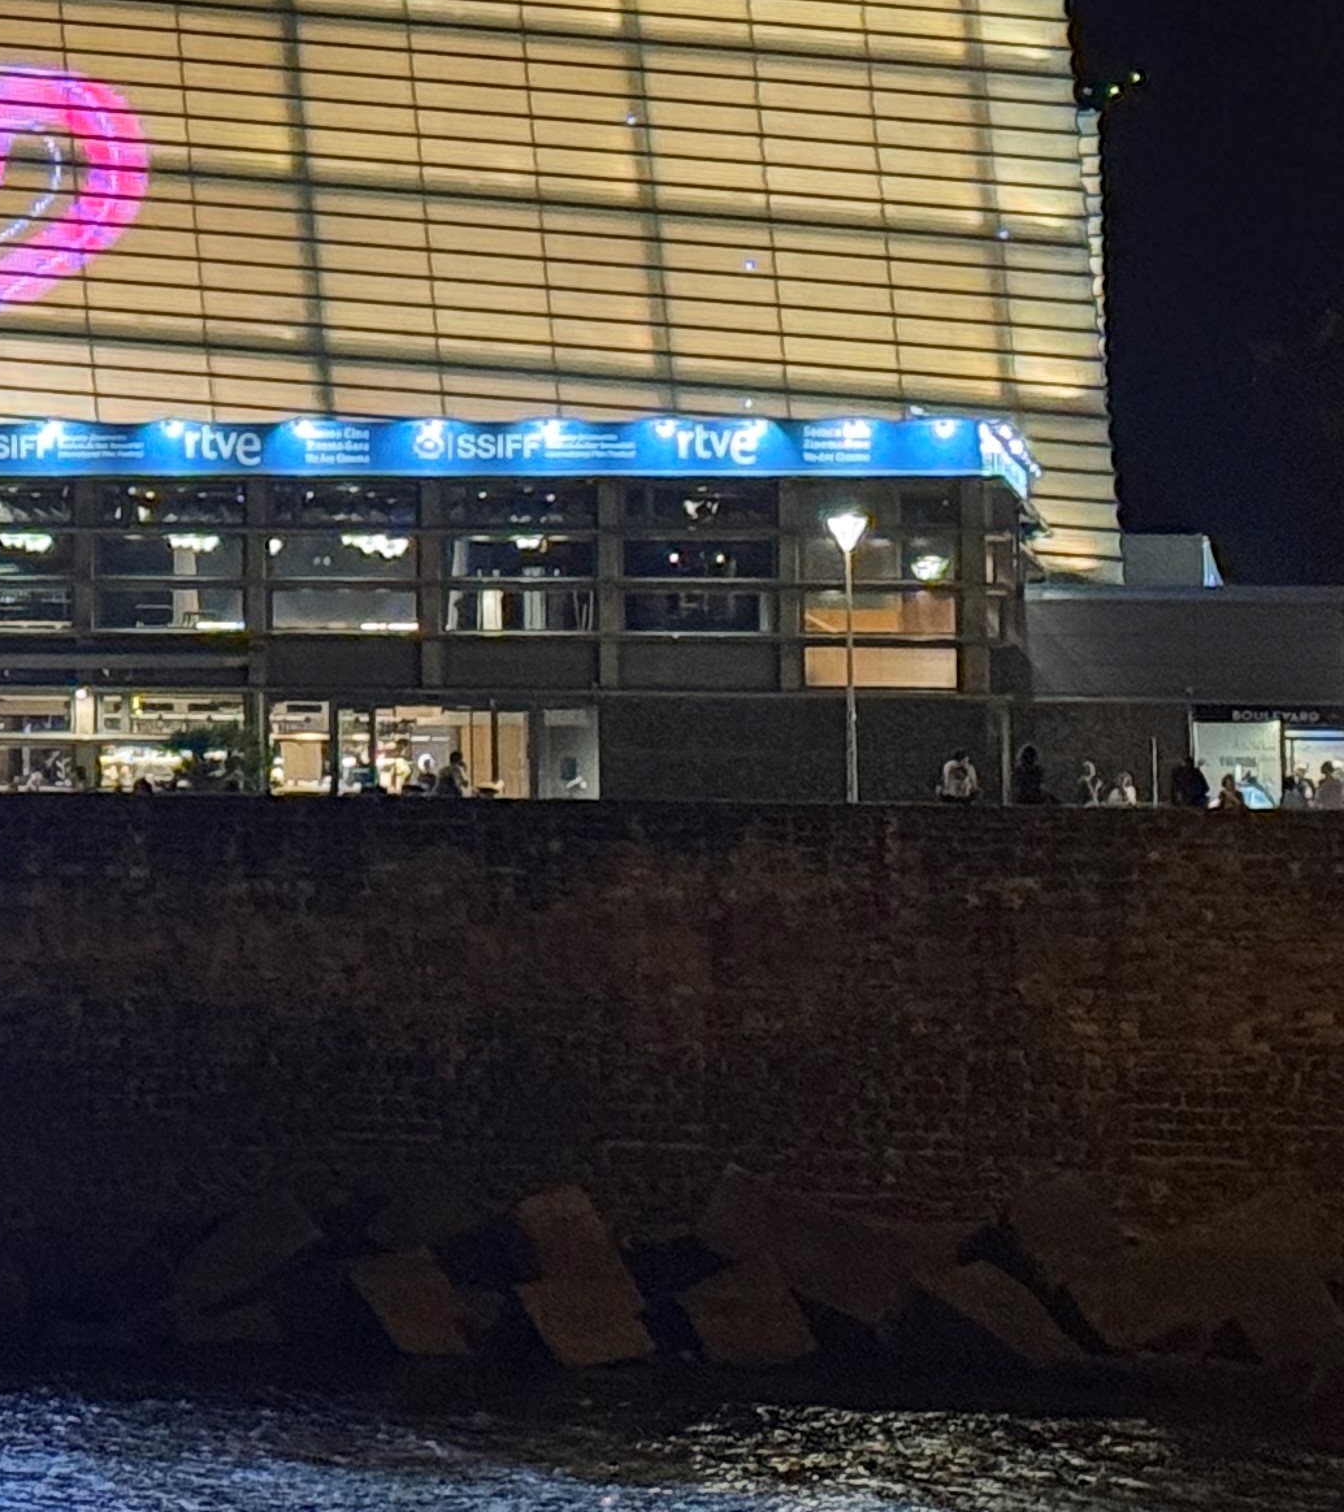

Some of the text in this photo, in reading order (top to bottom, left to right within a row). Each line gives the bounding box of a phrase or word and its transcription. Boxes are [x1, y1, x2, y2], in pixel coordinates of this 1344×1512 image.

[184, 426, 262, 466] rtve
[456, 433, 542, 459] SSIFF
[676, 424, 758, 465] rtve
